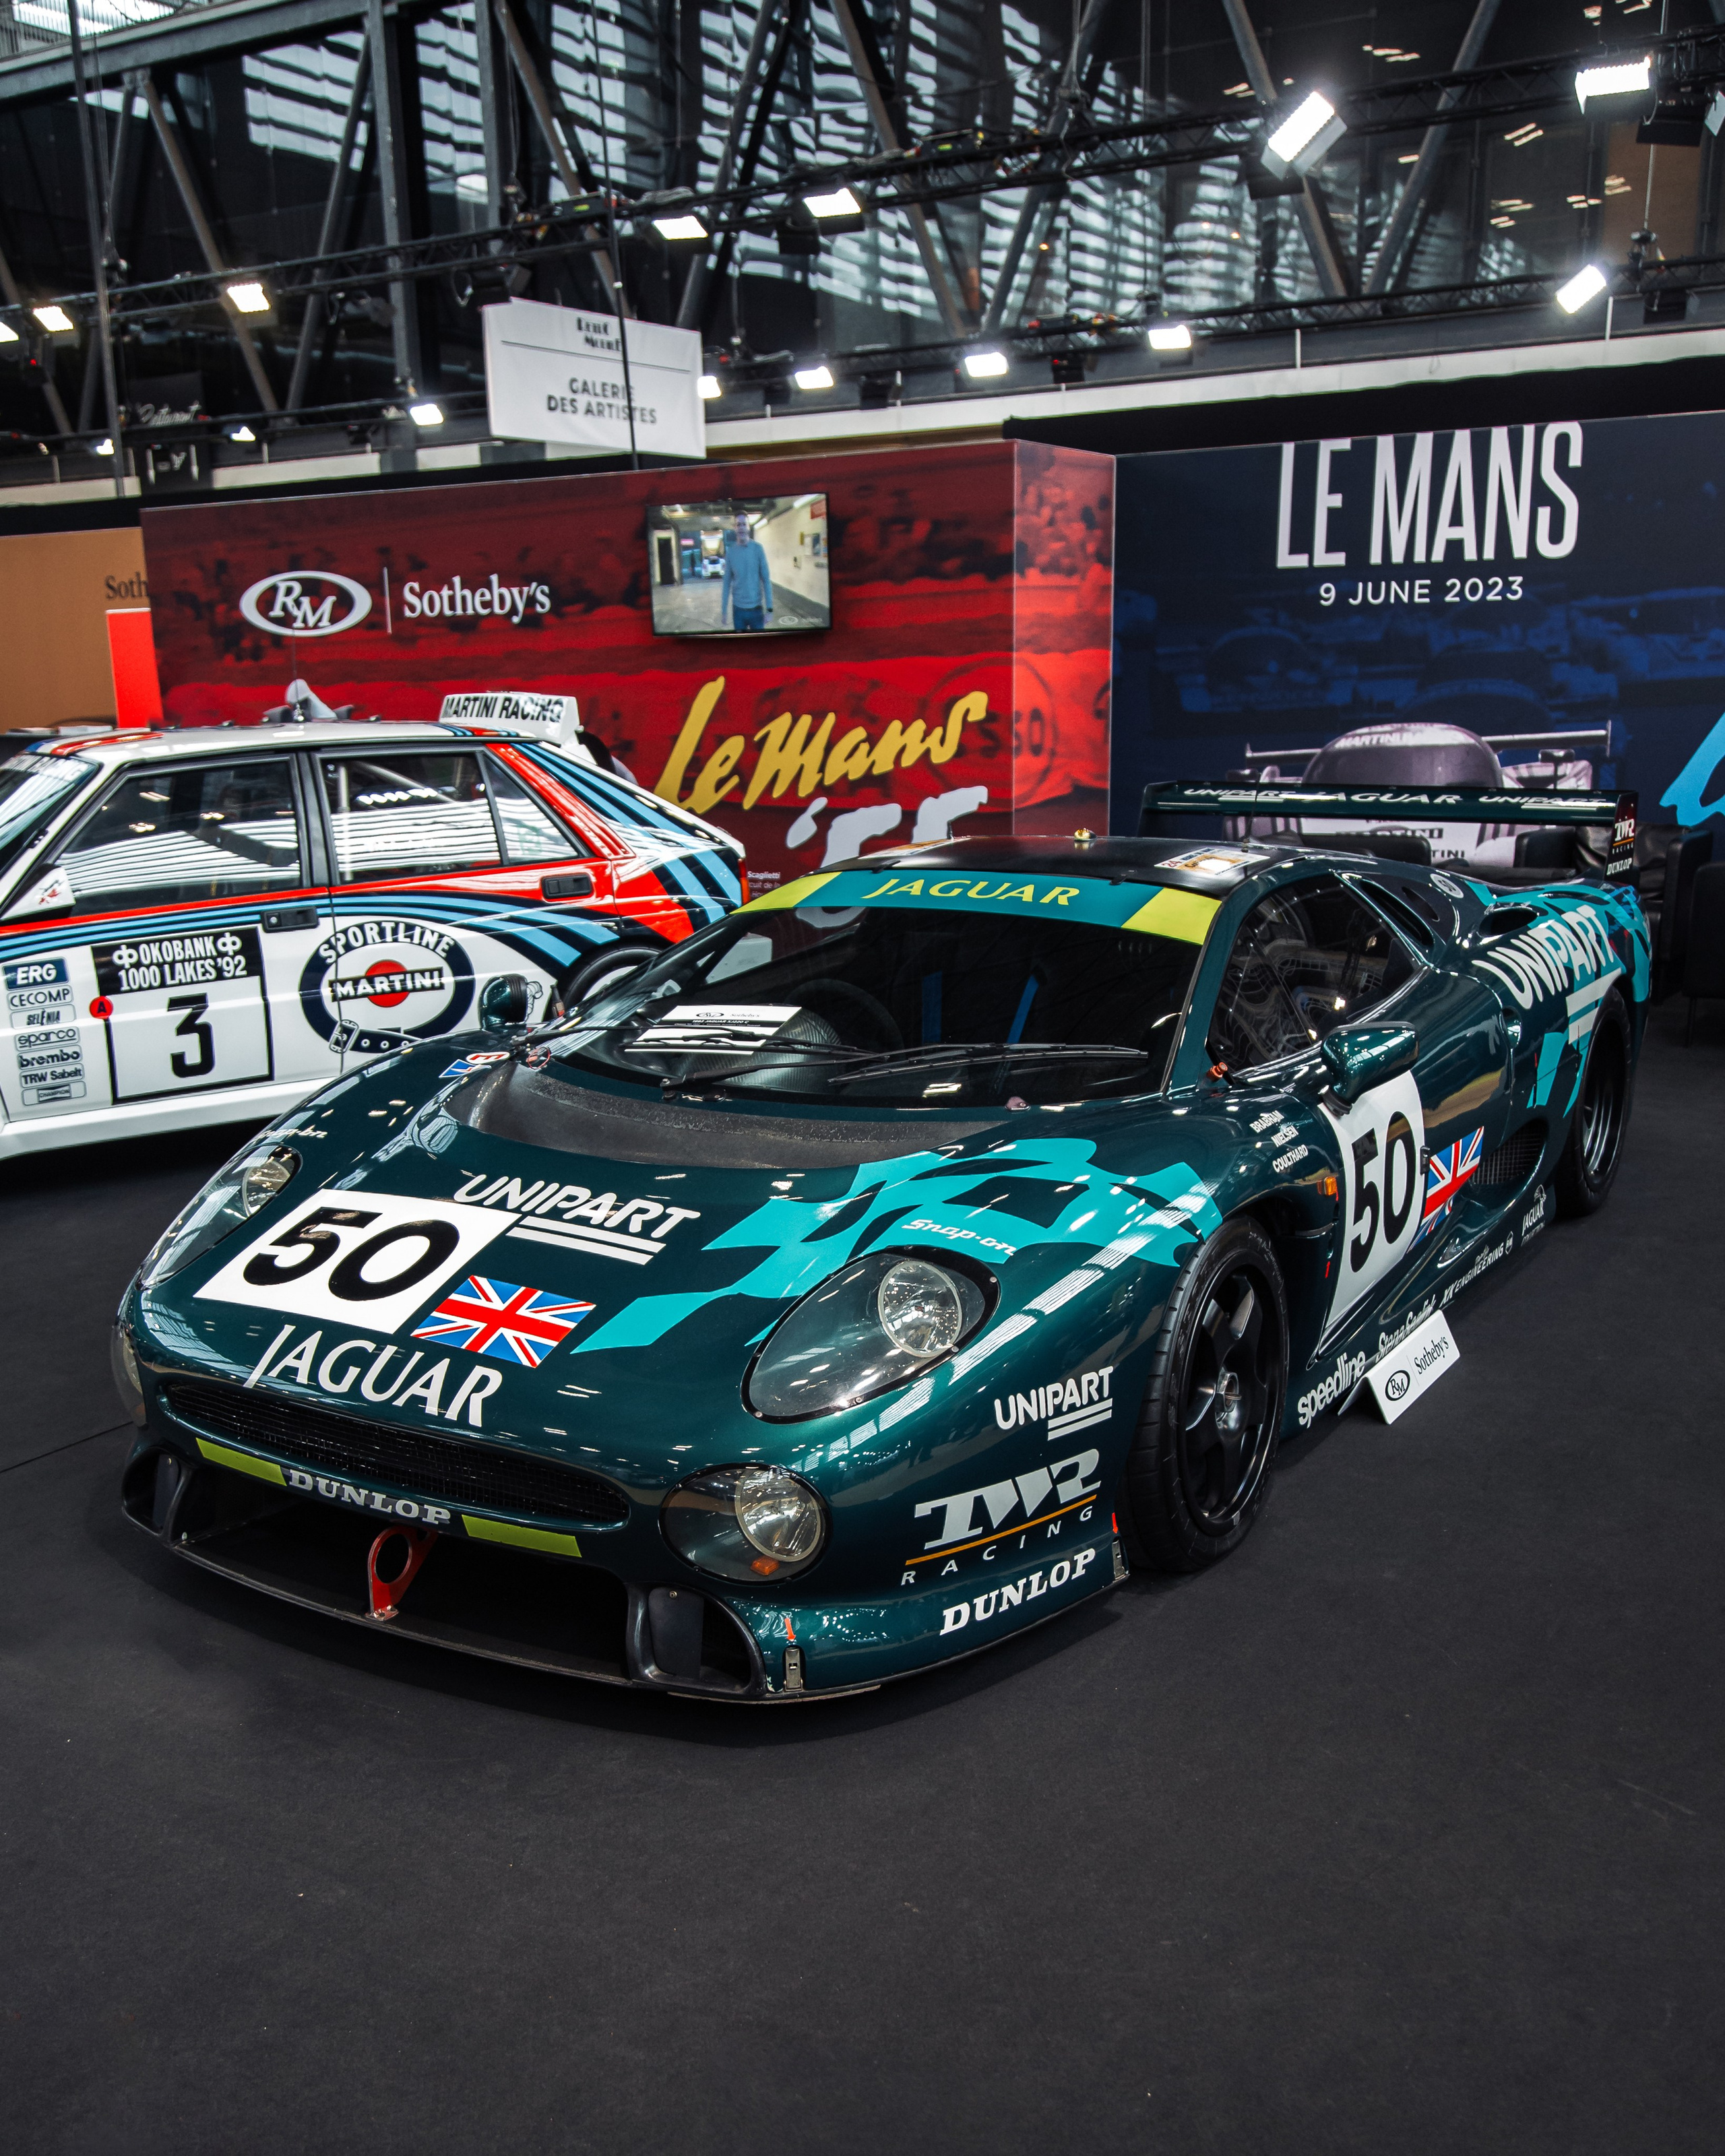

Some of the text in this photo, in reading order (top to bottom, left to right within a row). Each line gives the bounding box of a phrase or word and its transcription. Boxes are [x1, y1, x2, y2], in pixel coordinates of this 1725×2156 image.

[546, 393, 578, 414] DES
[1276, 420, 1583, 568] LE MANS
[403, 573, 552, 624] Sotheby's
[1319, 575, 1525, 606] 9 JUNE 2023
[441, 695, 499, 719] MARTINI
[1183, 788, 1296, 798] UNIPART
[1478, 795, 1607, 804] UNIPART
[1614, 818, 1635, 842] TWR
[1612, 842, 1635, 855] RACING
[1606, 857, 1633, 876] DUNLOP
[860, 878, 1080, 906] JAGUAR
[139, 935, 218, 965] OKOBANK
[318, 921, 456, 965] SPORTLINE
[1471, 904, 1615, 1010] UNIPART
[15, 962, 57, 986] ERG
[118, 955, 248, 992] 1000 LAKES '92
[334, 970, 441, 998] MARTINI
[10, 988, 71, 1008] CECOMP
[97, 1001, 107, 1015] A
[18, 1027, 76, 1048] sparco
[167, 992, 216, 1079] 3
[18, 1049, 81, 1069] brembo
[21, 1067, 83, 1085] TRW Sabelt
[1249, 1110, 1285, 1133] BRABHAM
[1270, 1124, 1299, 1147] NIELSEN
[1272, 1144, 1309, 1173] COULTHARD
[454, 1172, 701, 1240] UNIPART
[1349, 1110, 1416, 1273] 50
[1522, 1200, 1544, 1236] JAGUAR
[241, 1205, 460, 1302] 50
[902, 1217, 1017, 1257] Snap-on
[1454, 1242, 1505, 1293] ENGINEERING
[1414, 1335, 1449, 1374] Sotheby's
[242, 1323, 503, 1428] JAGUAR
[1297, 1350, 1367, 1429] speedline
[994, 1365, 1115, 1431] UNIPART
[288, 1468, 452, 1525] DUNLOP
[914, 1448, 1102, 1549] TWR
[901, 1504, 1095, 1587] RACING
[939, 1548, 1096, 1636] DUNLOP
